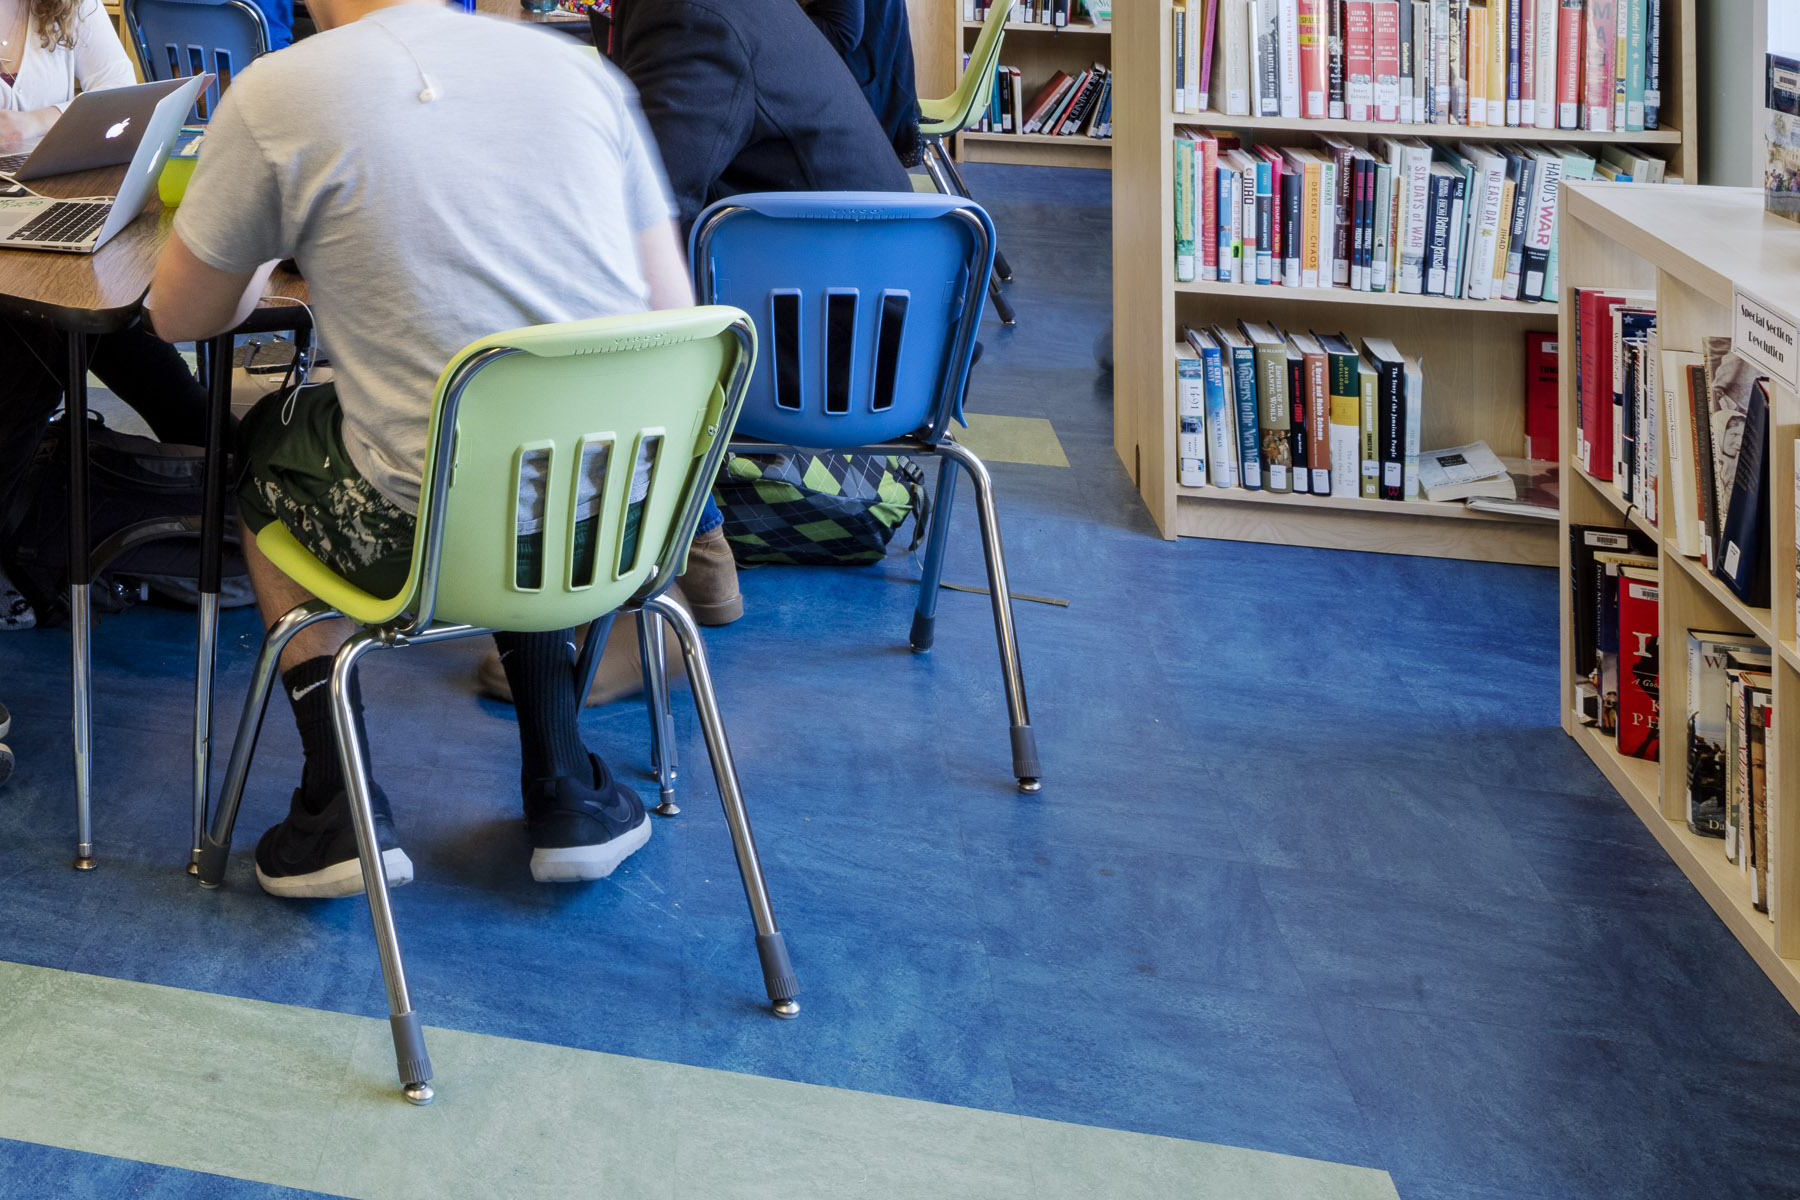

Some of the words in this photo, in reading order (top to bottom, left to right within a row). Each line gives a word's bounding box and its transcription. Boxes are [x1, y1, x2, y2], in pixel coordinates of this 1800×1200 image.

[1524, 19, 1532, 30] The
[1618, 0, 1626, 35] JAPAN
[1570, 22, 1578, 37] THE
[1439, 40, 1448, 52] The
[1524, 32, 1533, 54] Duke
[1569, 39, 1577, 60] RUINS
[1632, 34, 1640, 47] War
[1402, 42, 1410, 74] Gorbachev
[1524, 65, 1534, 84] Alba
[1568, 74, 1576, 100] EMPIRE
[1414, 166, 1426, 182] SIX
[1490, 170, 1501, 182] NO
[1542, 162, 1560, 203] HANOI'S
[1221, 180, 1229, 198] Mao
[1243, 177, 1254, 205] MAO
[1413, 186, 1425, 210] DAYS
[1456, 182, 1464, 197] IRAQ
[1487, 186, 1500, 207] EASY
[1310, 181, 1318, 220] DESCENT
[1518, 196, 1526, 206] Ho
[1412, 214, 1424, 222] of
[1485, 210, 1497, 228] DAY
[1516, 206, 1524, 218] Chi
[1436, 216, 1448, 236] Beirut
[1514, 218, 1524, 235] Minh
[1536, 205, 1554, 246] WAR
[1411, 226, 1423, 248] WAR
[1498, 228, 1508, 250] JIHAD
[1740, 304, 1764, 328] Special
[1766, 319, 1793, 346] Section:
[1748, 330, 1784, 363] Revolution
[1206, 356, 1214, 382] JOURNEY
[1214, 367, 1222, 387] GREAT
[1268, 360, 1276, 394] ATLANTIC
[1315, 368, 1323, 386] Great
[1238, 362, 1254, 400] Voyagers
[1390, 379, 1398, 394] Story
[1190, 386, 1200, 410] 1491
[1242, 402, 1252, 410] to
[1316, 397, 1324, 416] Noble
[1694, 370, 1704, 426] REAGAN'S
[1242, 411, 1254, 426] the
[1269, 396, 1278, 422] WORLD
[1316, 417, 1324, 440] Scheme
[1390, 414, 1398, 438] Jamaican
[1244, 428, 1256, 449] New
[1390, 440, 1398, 458] People
[1698, 431, 1706, 455] WAR
